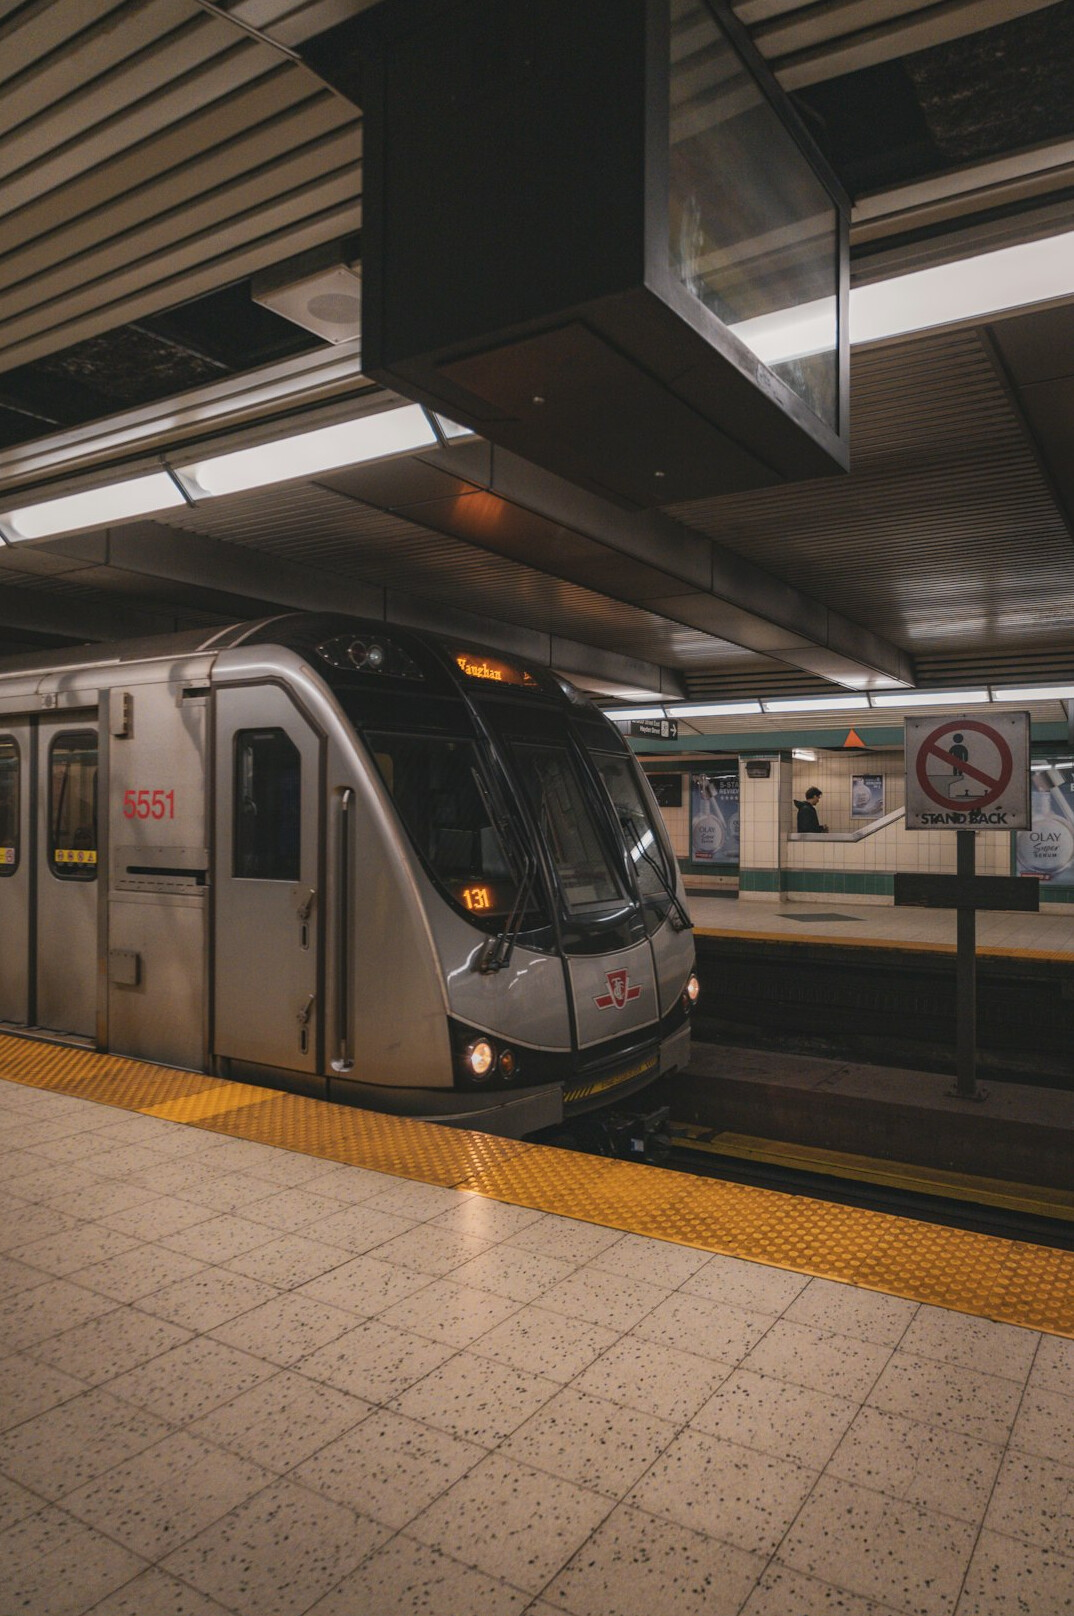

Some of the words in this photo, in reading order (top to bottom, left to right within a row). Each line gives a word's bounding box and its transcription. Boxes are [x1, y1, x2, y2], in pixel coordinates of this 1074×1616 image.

[457, 658, 502, 680] Vaughan
[123, 789, 174, 820] 5551
[921, 812, 967, 825] STAND
[969, 812, 1008, 825] BACK
[1029, 832, 1061, 842] OLAY
[463, 889, 489, 909] 131
